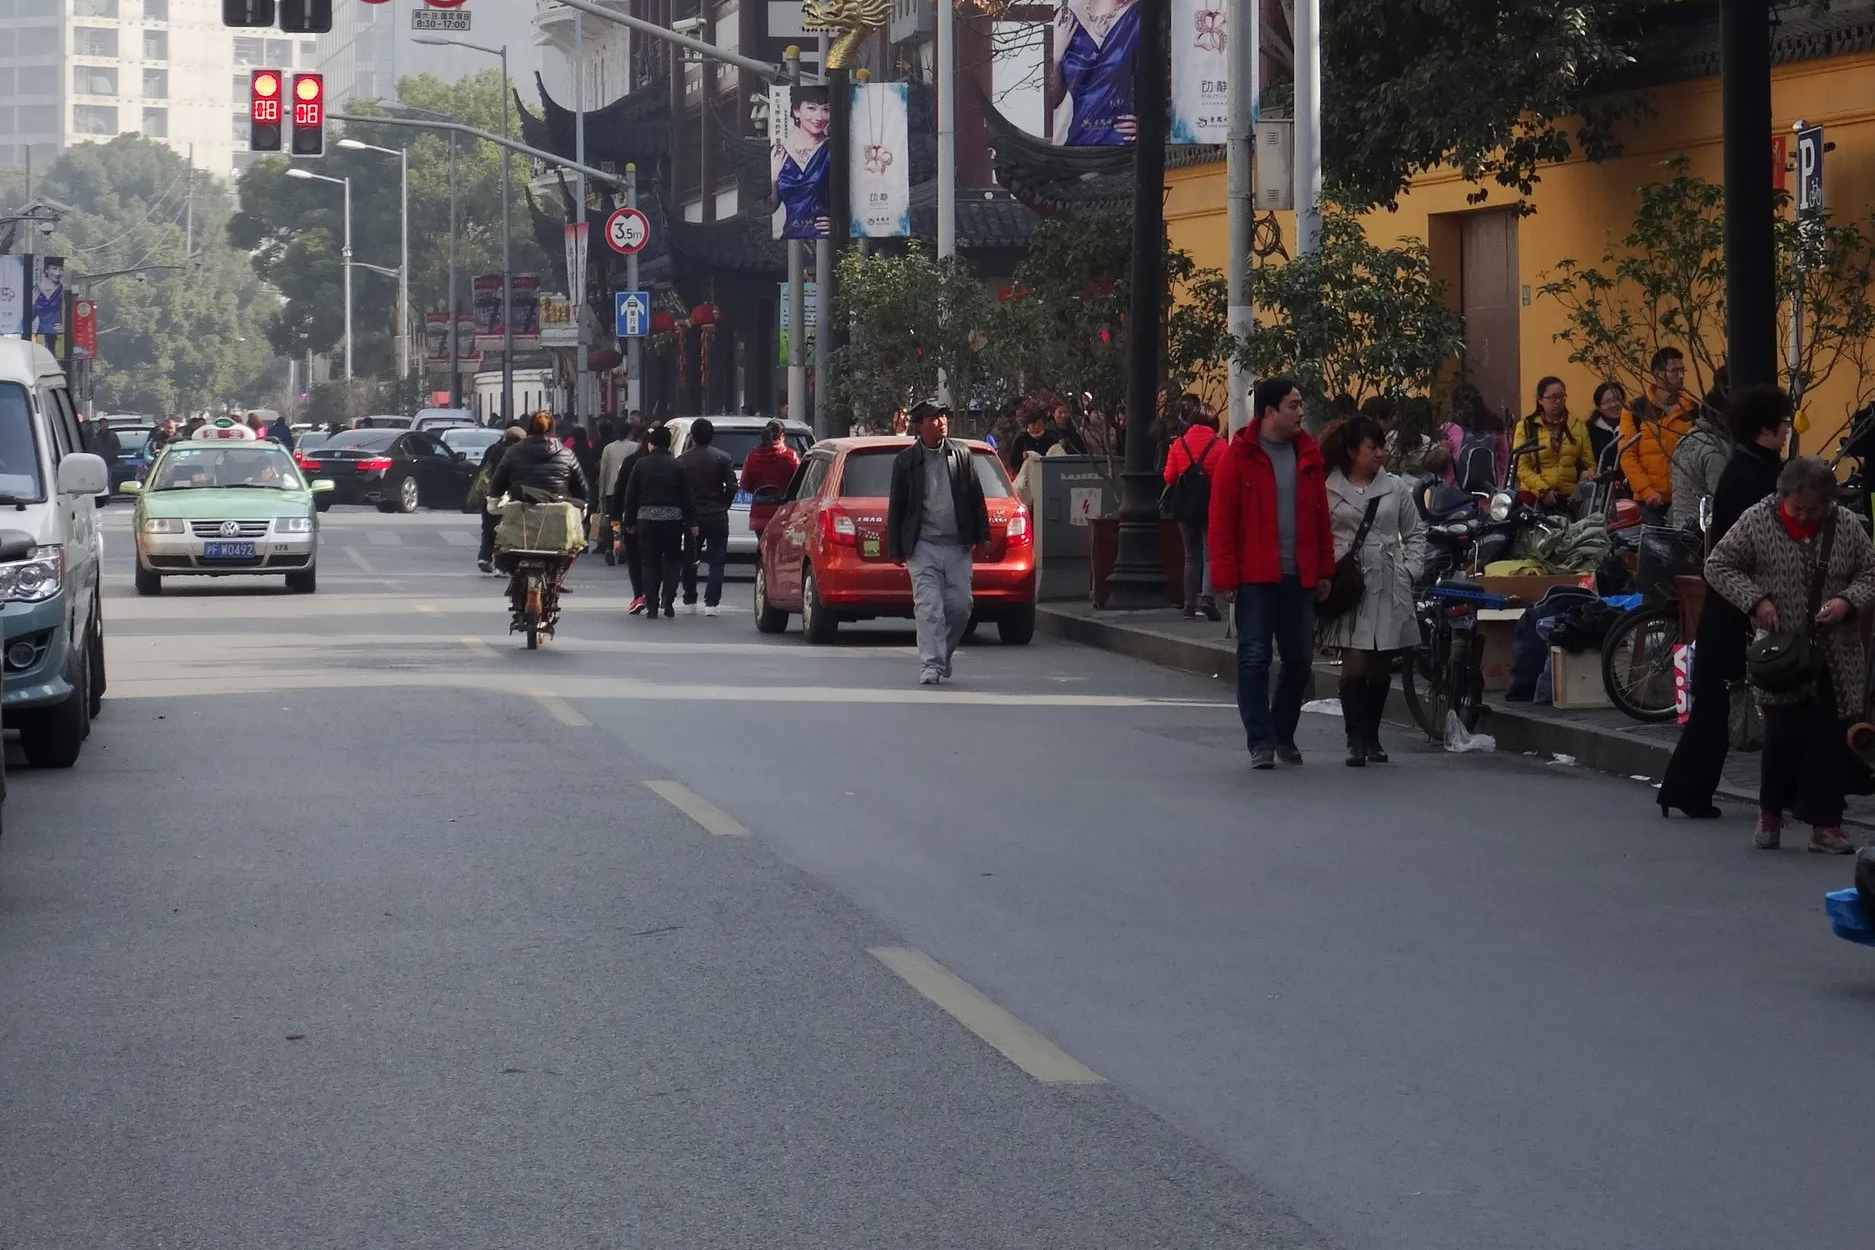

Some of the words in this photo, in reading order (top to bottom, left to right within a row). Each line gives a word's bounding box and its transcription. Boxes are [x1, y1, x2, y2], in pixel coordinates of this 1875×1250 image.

[255, 100, 277, 120] 08
[296, 104, 318, 124] 08
[1800, 138, 1815, 210] P
[615, 223, 642, 240] 3.5m
